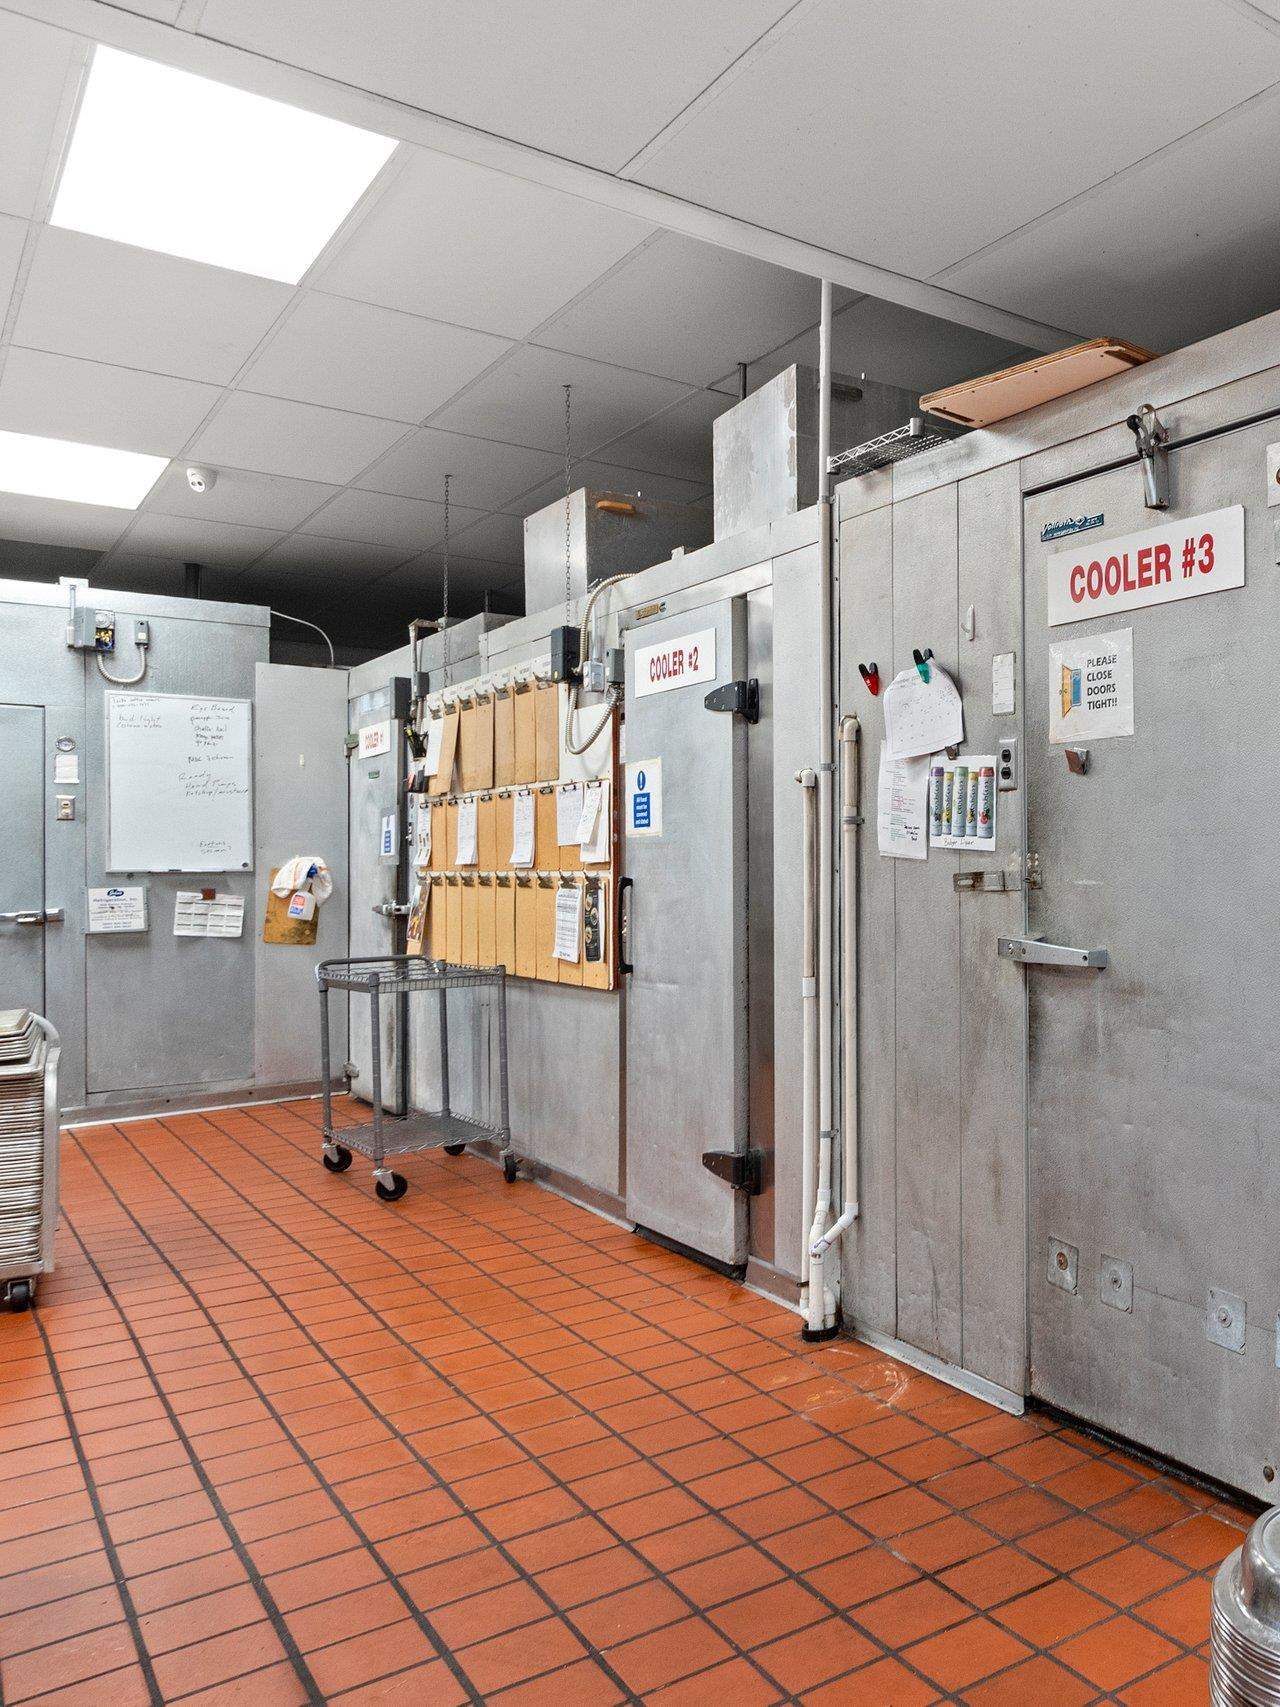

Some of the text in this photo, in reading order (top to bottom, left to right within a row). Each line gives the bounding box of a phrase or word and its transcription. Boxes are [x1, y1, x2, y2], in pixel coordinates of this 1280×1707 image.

[1069, 533, 1215, 604] COOLER #3
[649, 646, 699, 683] COOLER #2
[1086, 654, 1117, 668] PLEASE
[1086, 669, 1113, 682] CLOSE
[1086, 683, 1116, 696] DOORS
[1087, 697, 1118, 710] TIGHT!!
